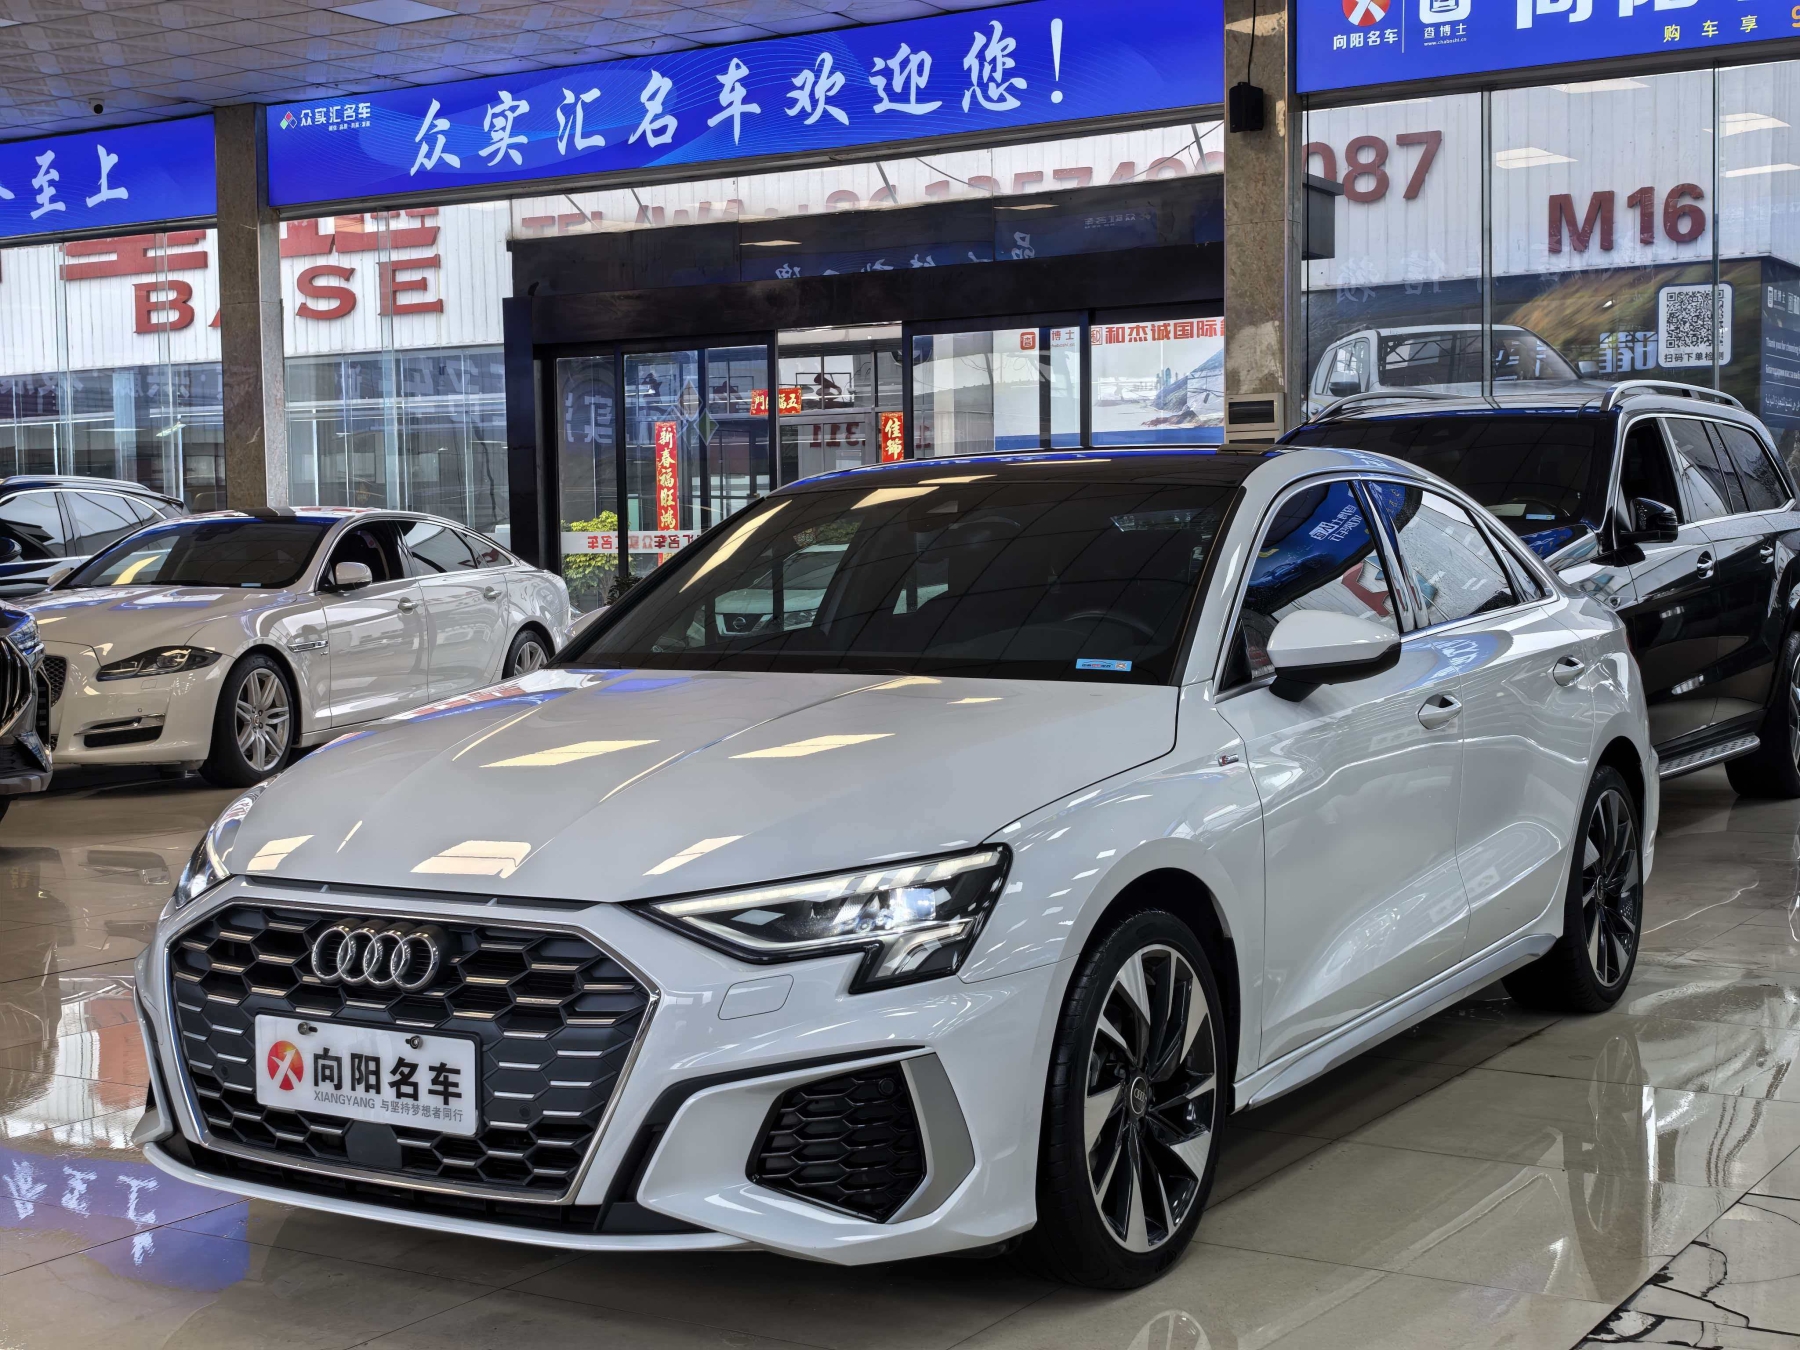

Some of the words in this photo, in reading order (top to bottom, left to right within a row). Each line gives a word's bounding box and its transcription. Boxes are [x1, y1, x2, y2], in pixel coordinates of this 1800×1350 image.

[1333, 28, 1398, 50] 向阳名车
[1423, 23, 1467, 39] 查博士
[300, 102, 371, 126] 众实汇名车
[1548, 183, 1707, 254] M16
[134, 253, 444, 334] BSE
[1051, 330, 1075, 341] 博士
[1104, 318, 1225, 344] 和杰诚国际
[313, 1047, 463, 1106] 向阳名车
[314, 1090, 376, 1109] XIANGYANG
[380, 1099, 464, 1122] 与坚持梦想者同行
